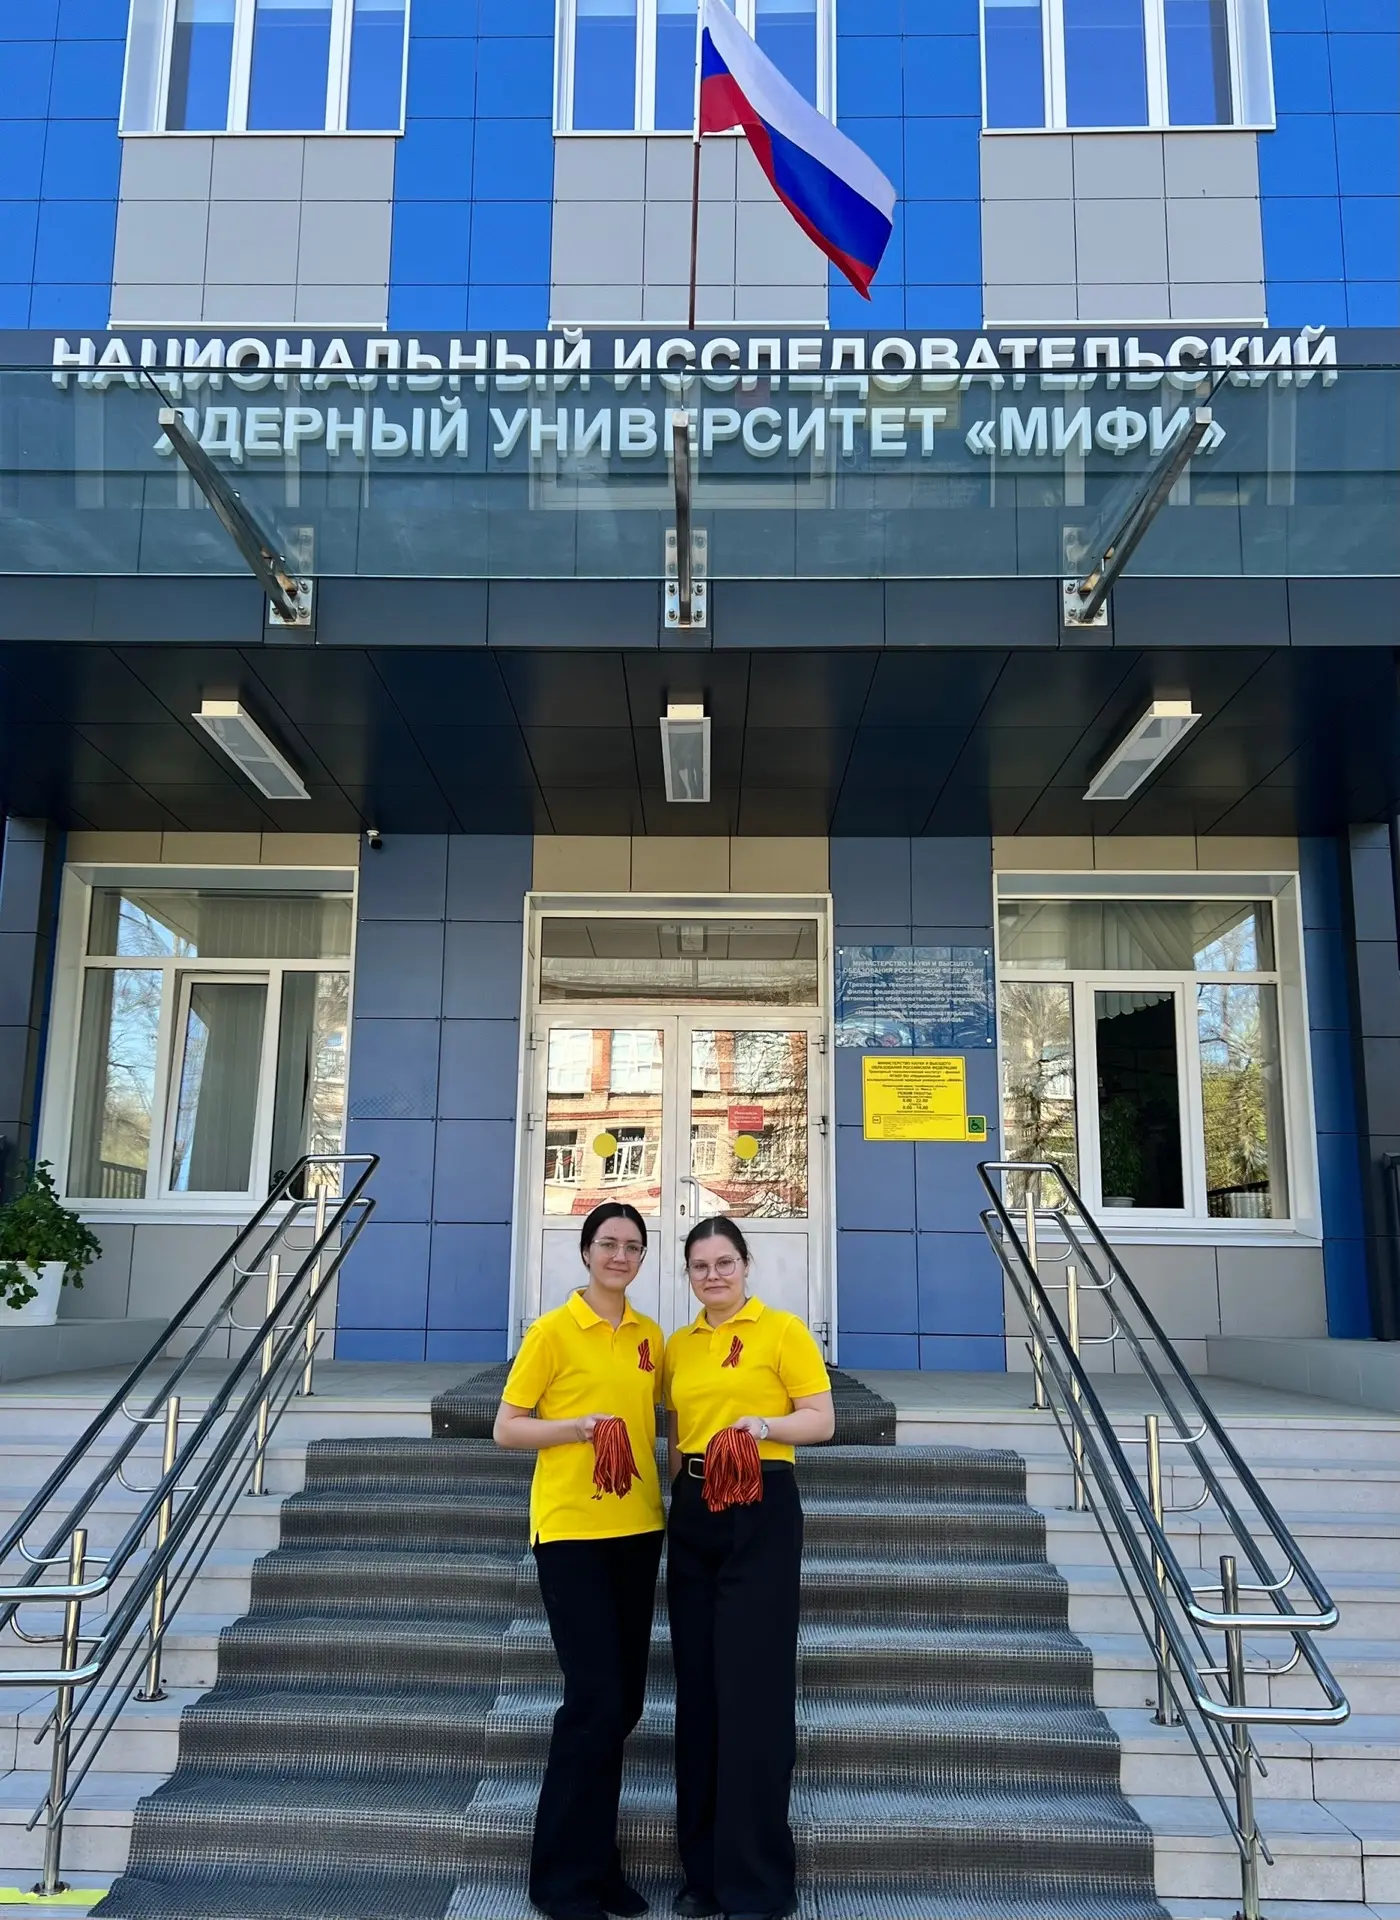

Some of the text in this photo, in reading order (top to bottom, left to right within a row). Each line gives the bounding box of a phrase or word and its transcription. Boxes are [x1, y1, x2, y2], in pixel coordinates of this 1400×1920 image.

[51, 325, 1339, 400] НАЦИОНАЛЬНЫЙ ИССЛЕДОВАТЕЛЬСКИЙ
[489, 407, 947, 458] УНИВЕРСИТЕТ
[965, 406, 1227, 456] «МИФИ»
